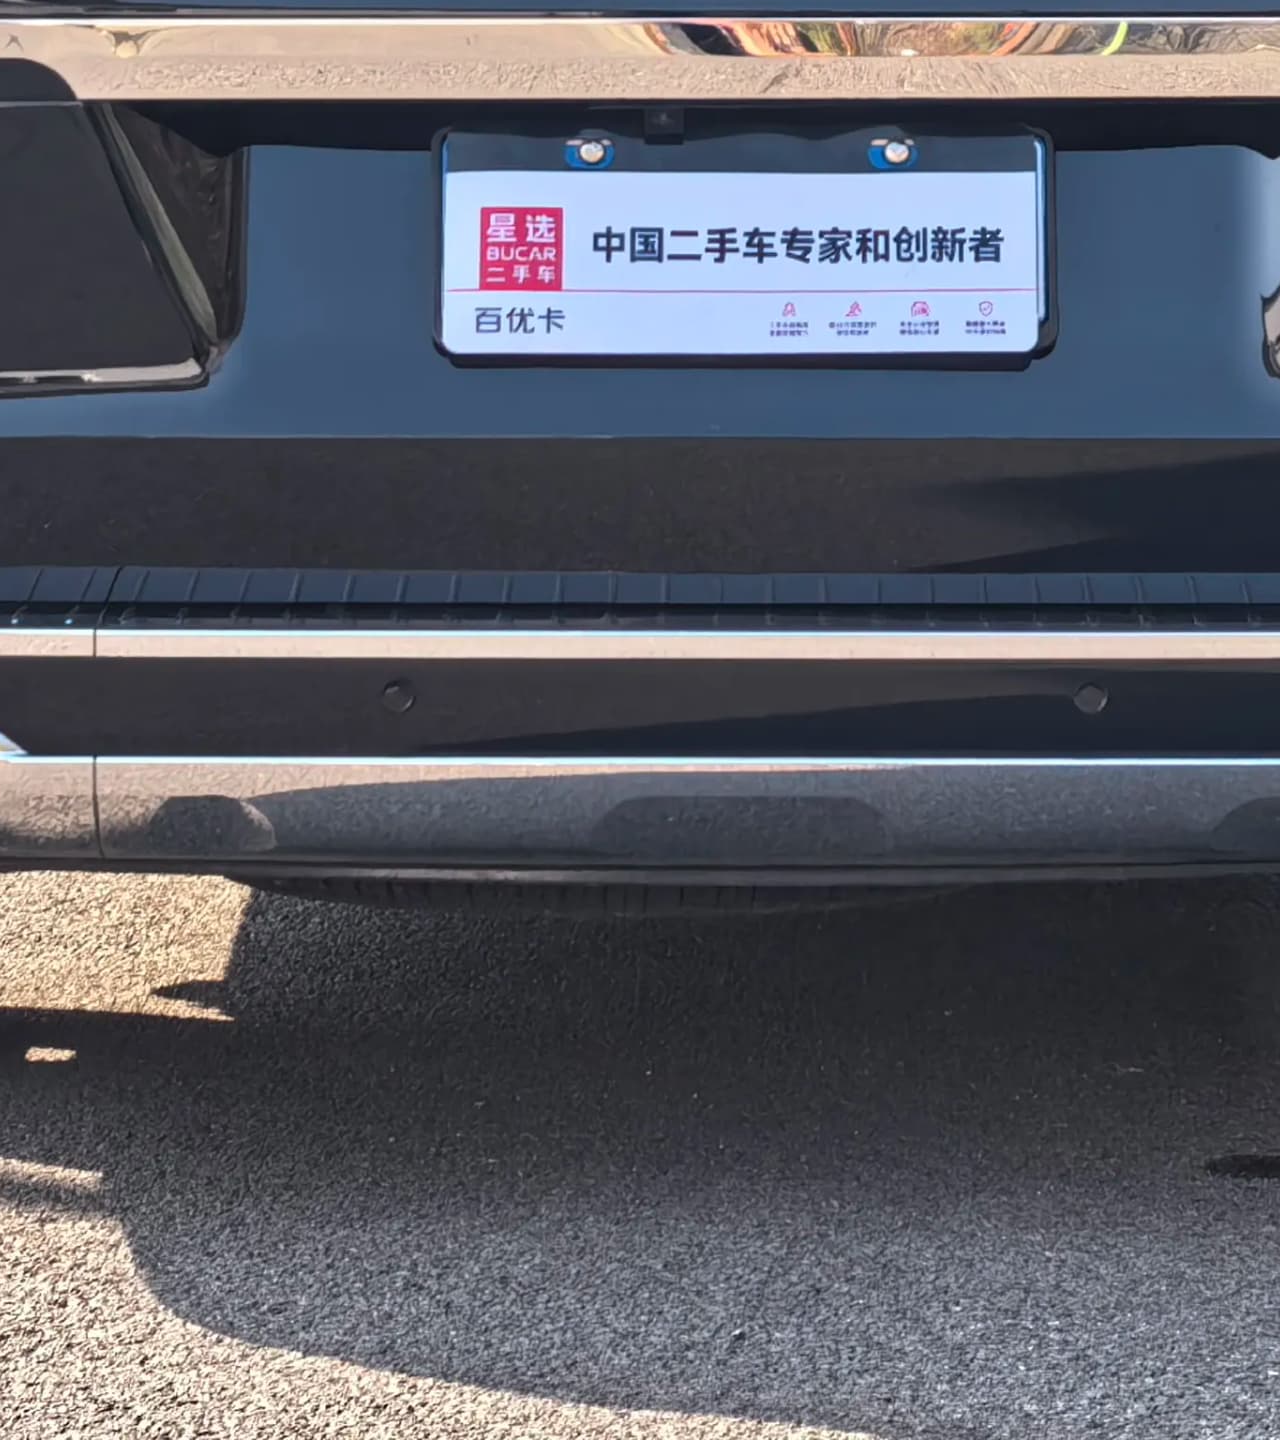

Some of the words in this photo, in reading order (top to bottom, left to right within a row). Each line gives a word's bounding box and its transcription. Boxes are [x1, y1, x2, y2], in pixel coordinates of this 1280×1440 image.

[487, 212, 556, 243] 星选
[486, 246, 557, 261] BUCAR
[592, 225, 1005, 265] 中国二手车专家和创新者
[486, 264, 556, 284] 二手车
[474, 306, 566, 334] 百优卡
